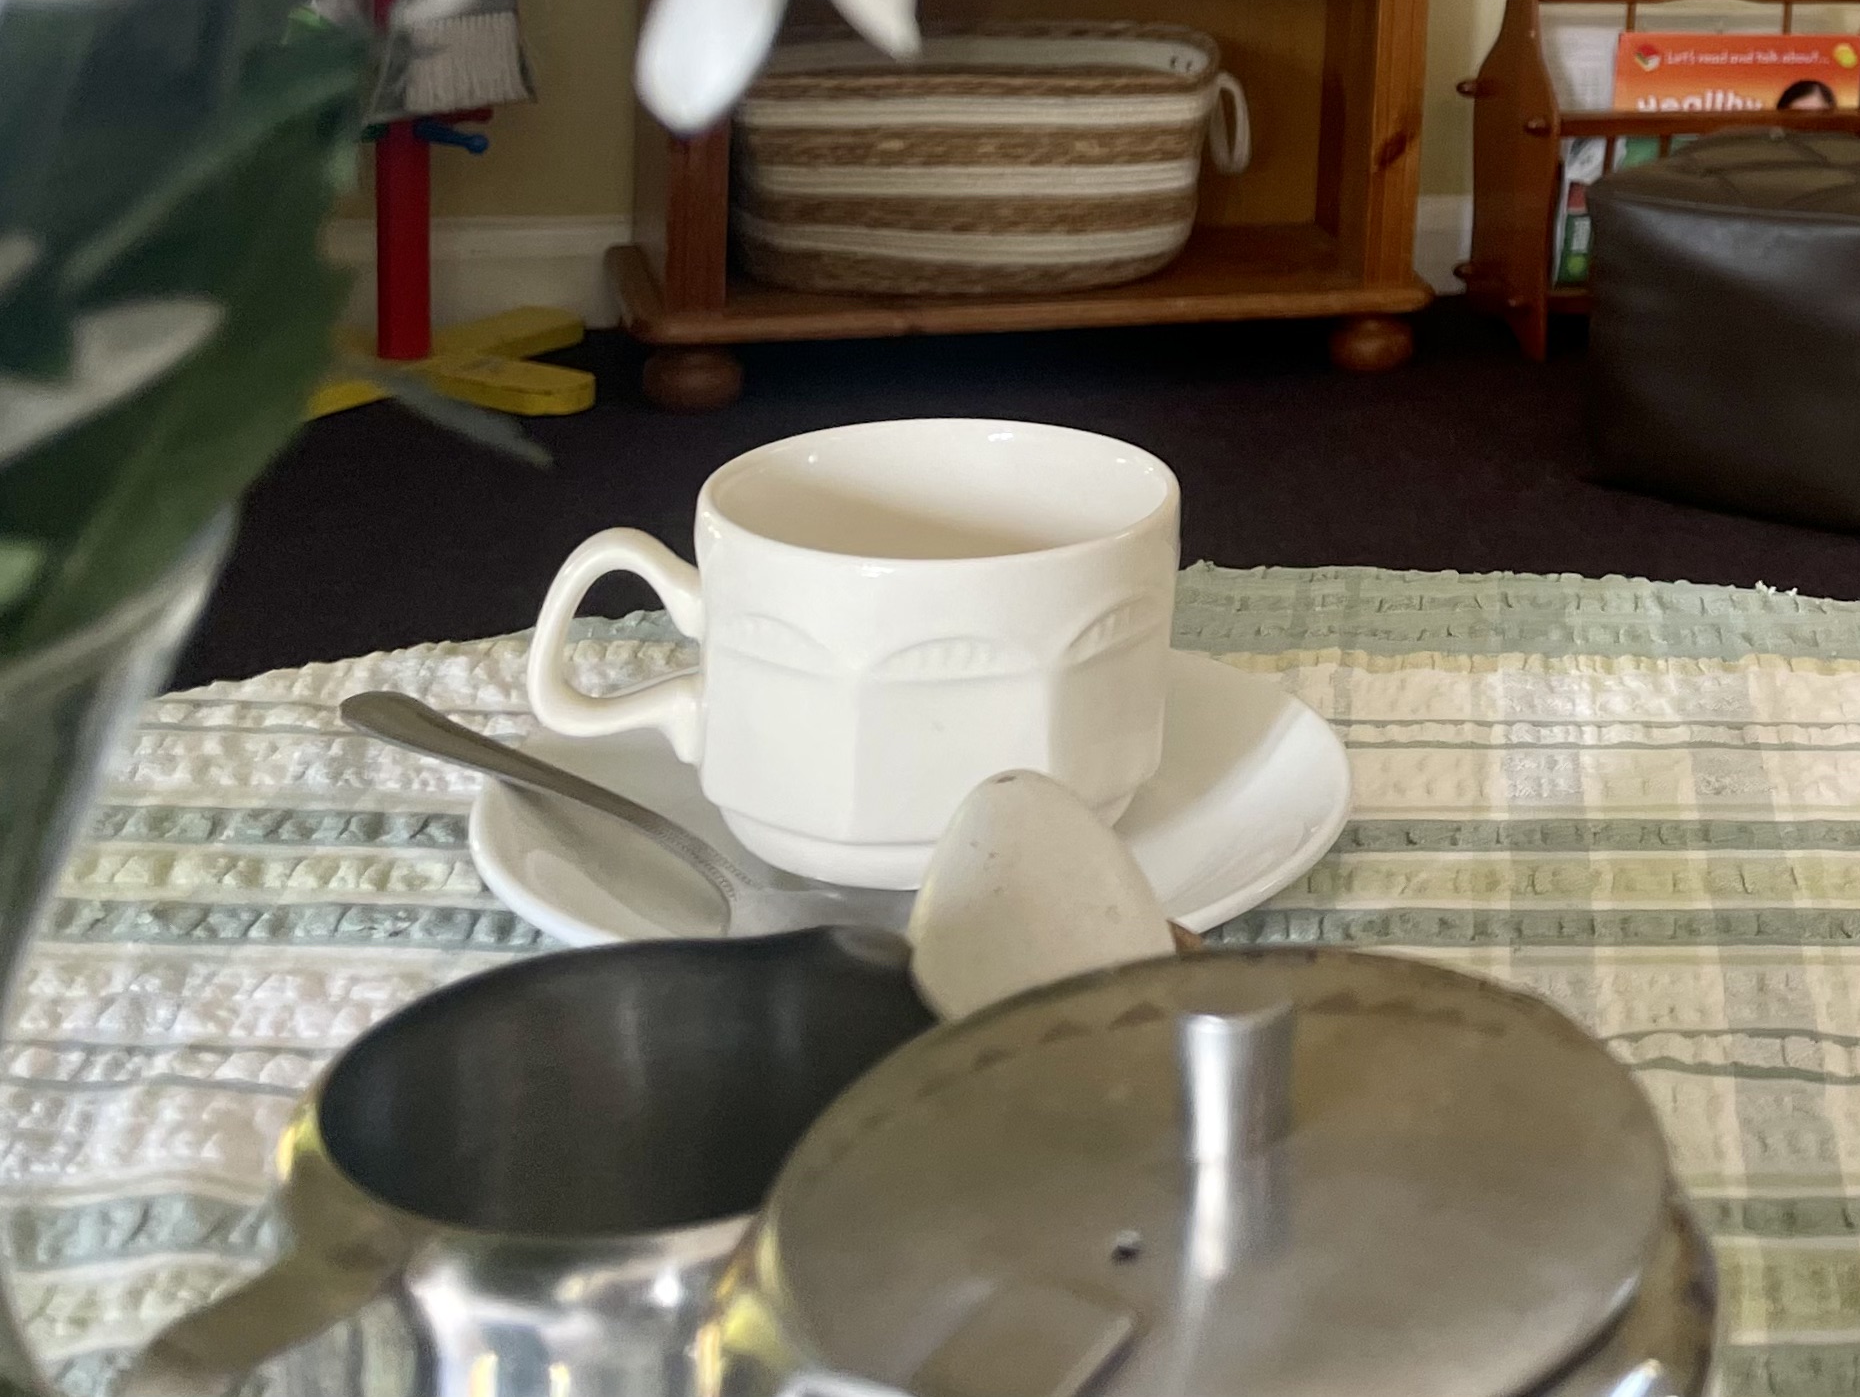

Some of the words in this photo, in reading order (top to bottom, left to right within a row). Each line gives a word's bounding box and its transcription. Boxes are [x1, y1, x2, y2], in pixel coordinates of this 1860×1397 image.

[1666, 48, 1696, 66] Let's
[1698, 49, 1729, 65] read
[1730, 49, 1754, 65] and
